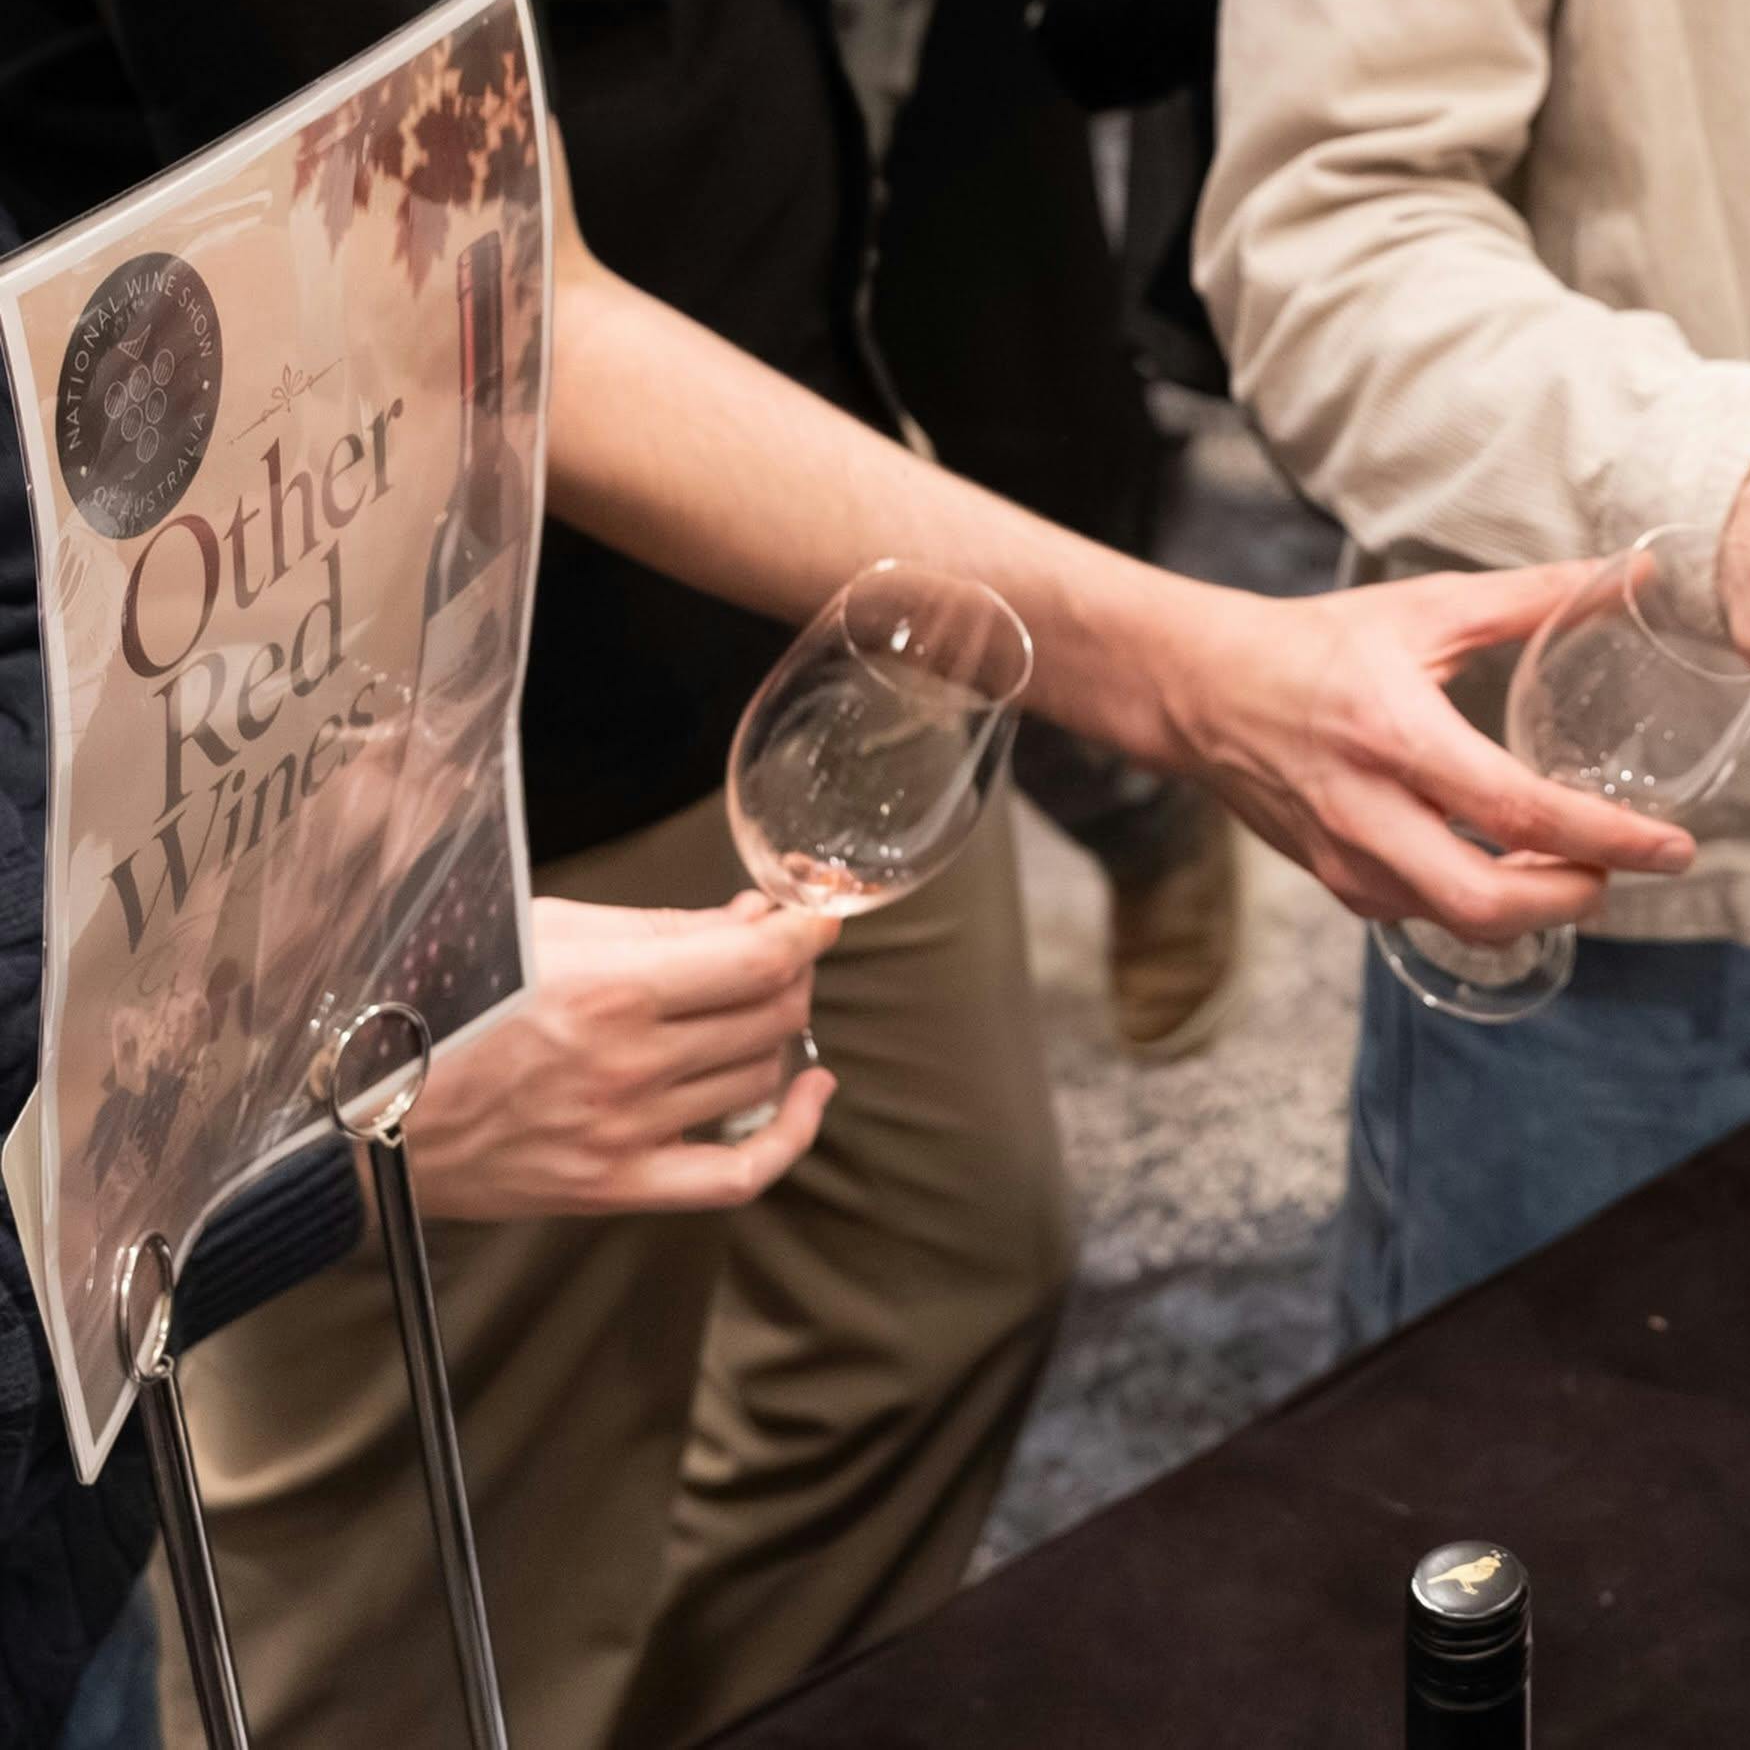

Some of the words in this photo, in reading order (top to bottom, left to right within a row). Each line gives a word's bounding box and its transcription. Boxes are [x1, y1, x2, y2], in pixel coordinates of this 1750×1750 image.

[66, 296, 121, 450] NATIONAL
[124, 270, 177, 299] WINE
[178, 286, 213, 358] SHOW
[119, 411, 206, 521] AUSTRALIA
[121, 398, 404, 679] Other
[102, 681, 377, 955] Wines
[153, 540, 346, 825] Red
